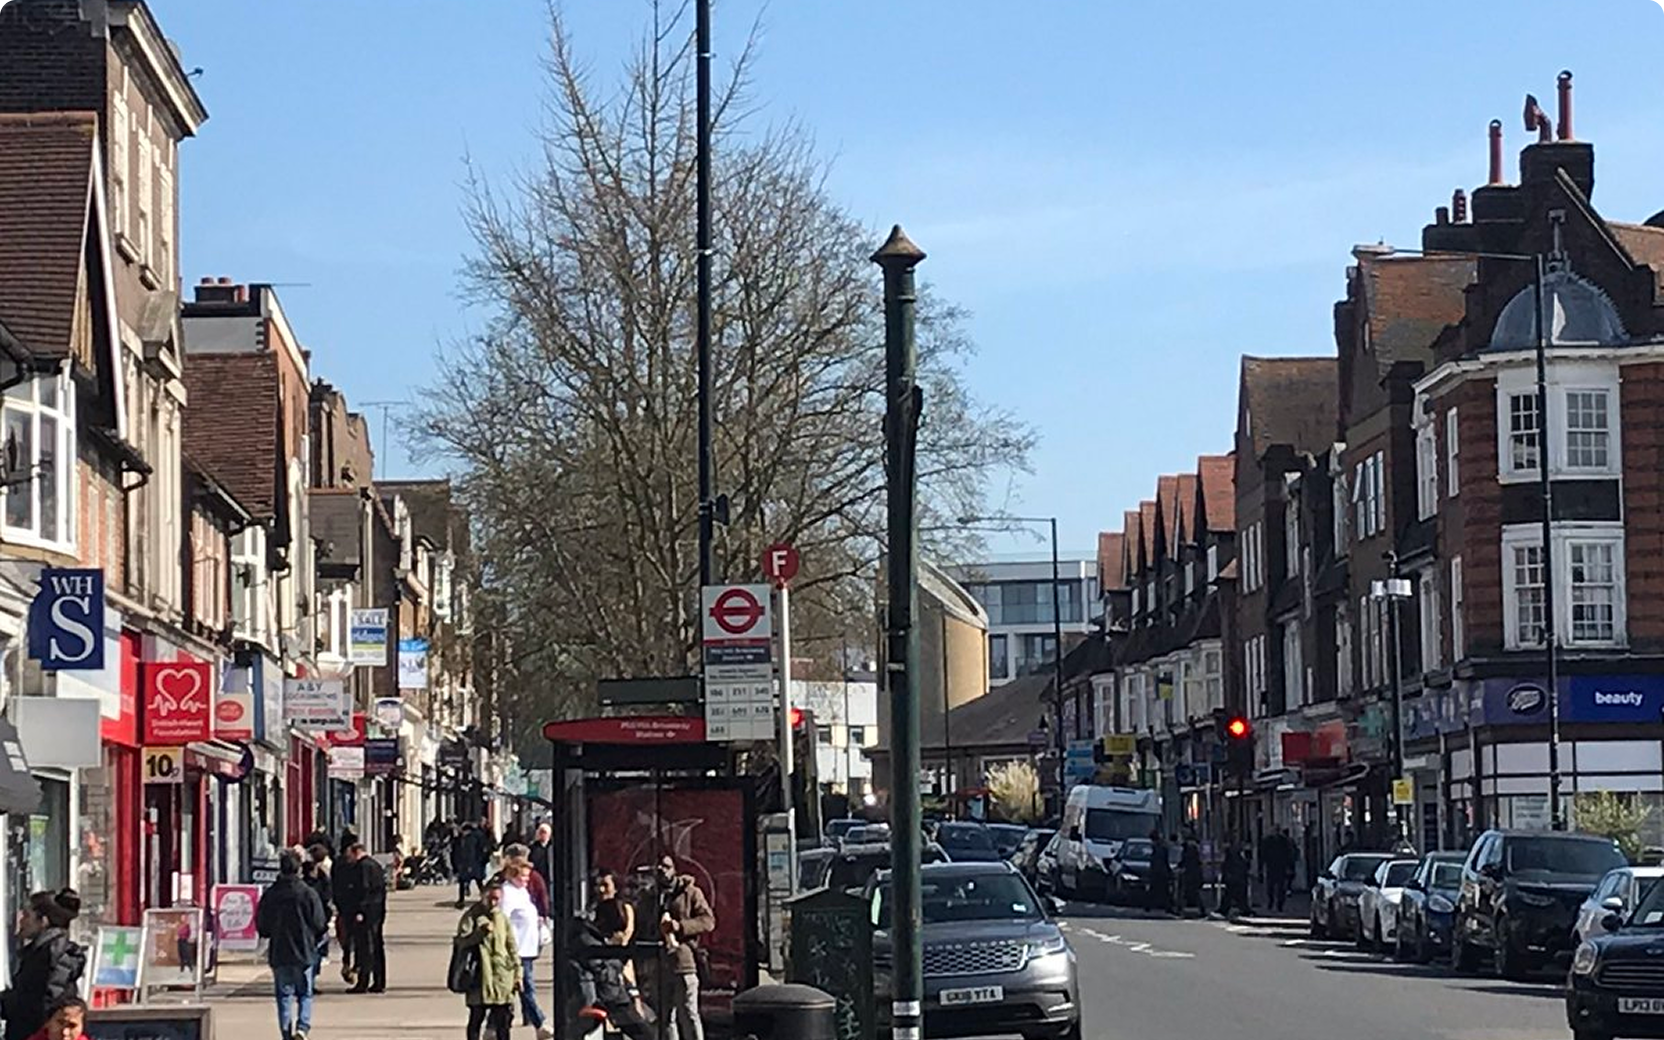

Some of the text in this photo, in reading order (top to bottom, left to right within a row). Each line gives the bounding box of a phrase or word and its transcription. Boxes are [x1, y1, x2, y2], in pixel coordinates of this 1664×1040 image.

[772, 550, 788, 576] F
[51, 576, 93, 595] WH
[50, 595, 95, 662] S
[1595, 691, 1643, 706] beauty
